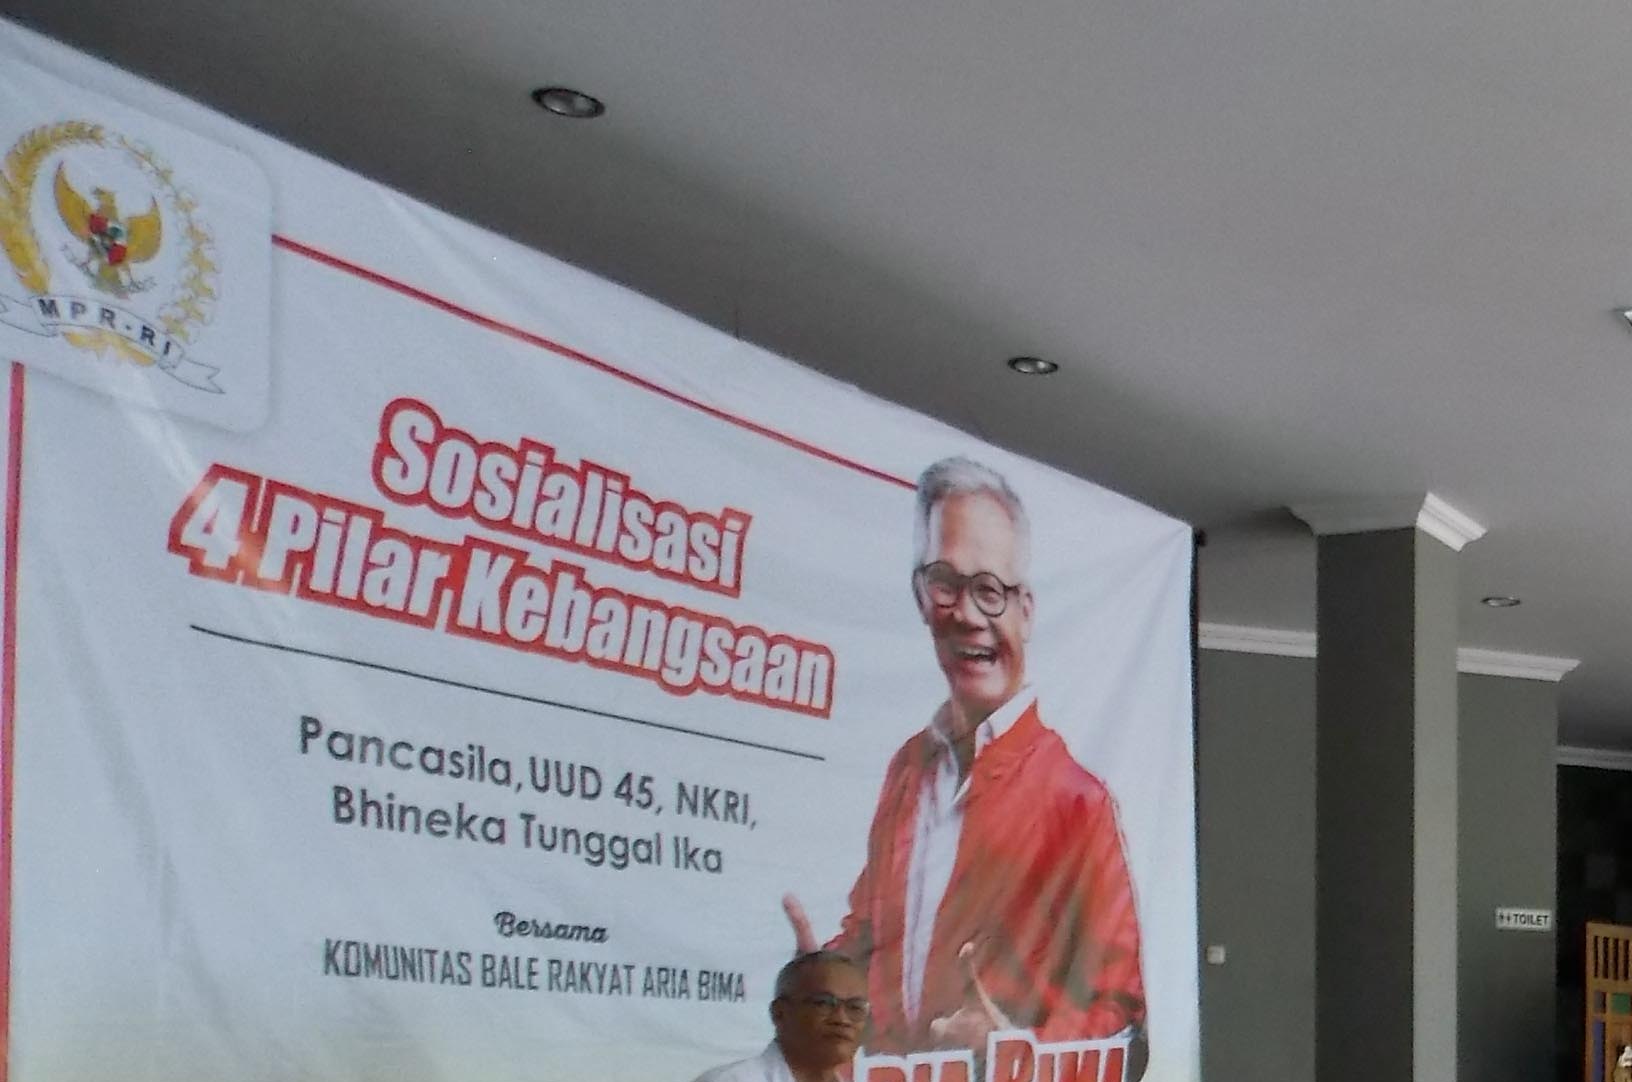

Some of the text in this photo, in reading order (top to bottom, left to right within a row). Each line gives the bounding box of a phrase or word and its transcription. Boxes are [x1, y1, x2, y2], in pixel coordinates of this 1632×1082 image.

[37, 297, 171, 356] MPR-RI
[373, 398, 751, 594] Sosialisasi
[173, 469, 834, 717] 4 Pilar Kebangsaan
[300, 714, 757, 831] Pancasila, UUD 45, NKRI,
[333, 785, 724, 874] Bhineka Tunggal Ika
[494, 911, 609, 943] Bersama
[1513, 913, 1549, 926] TOILET
[324, 938, 747, 1003] KOMUNITAS BALE RAKYAT ARIA BIMA
